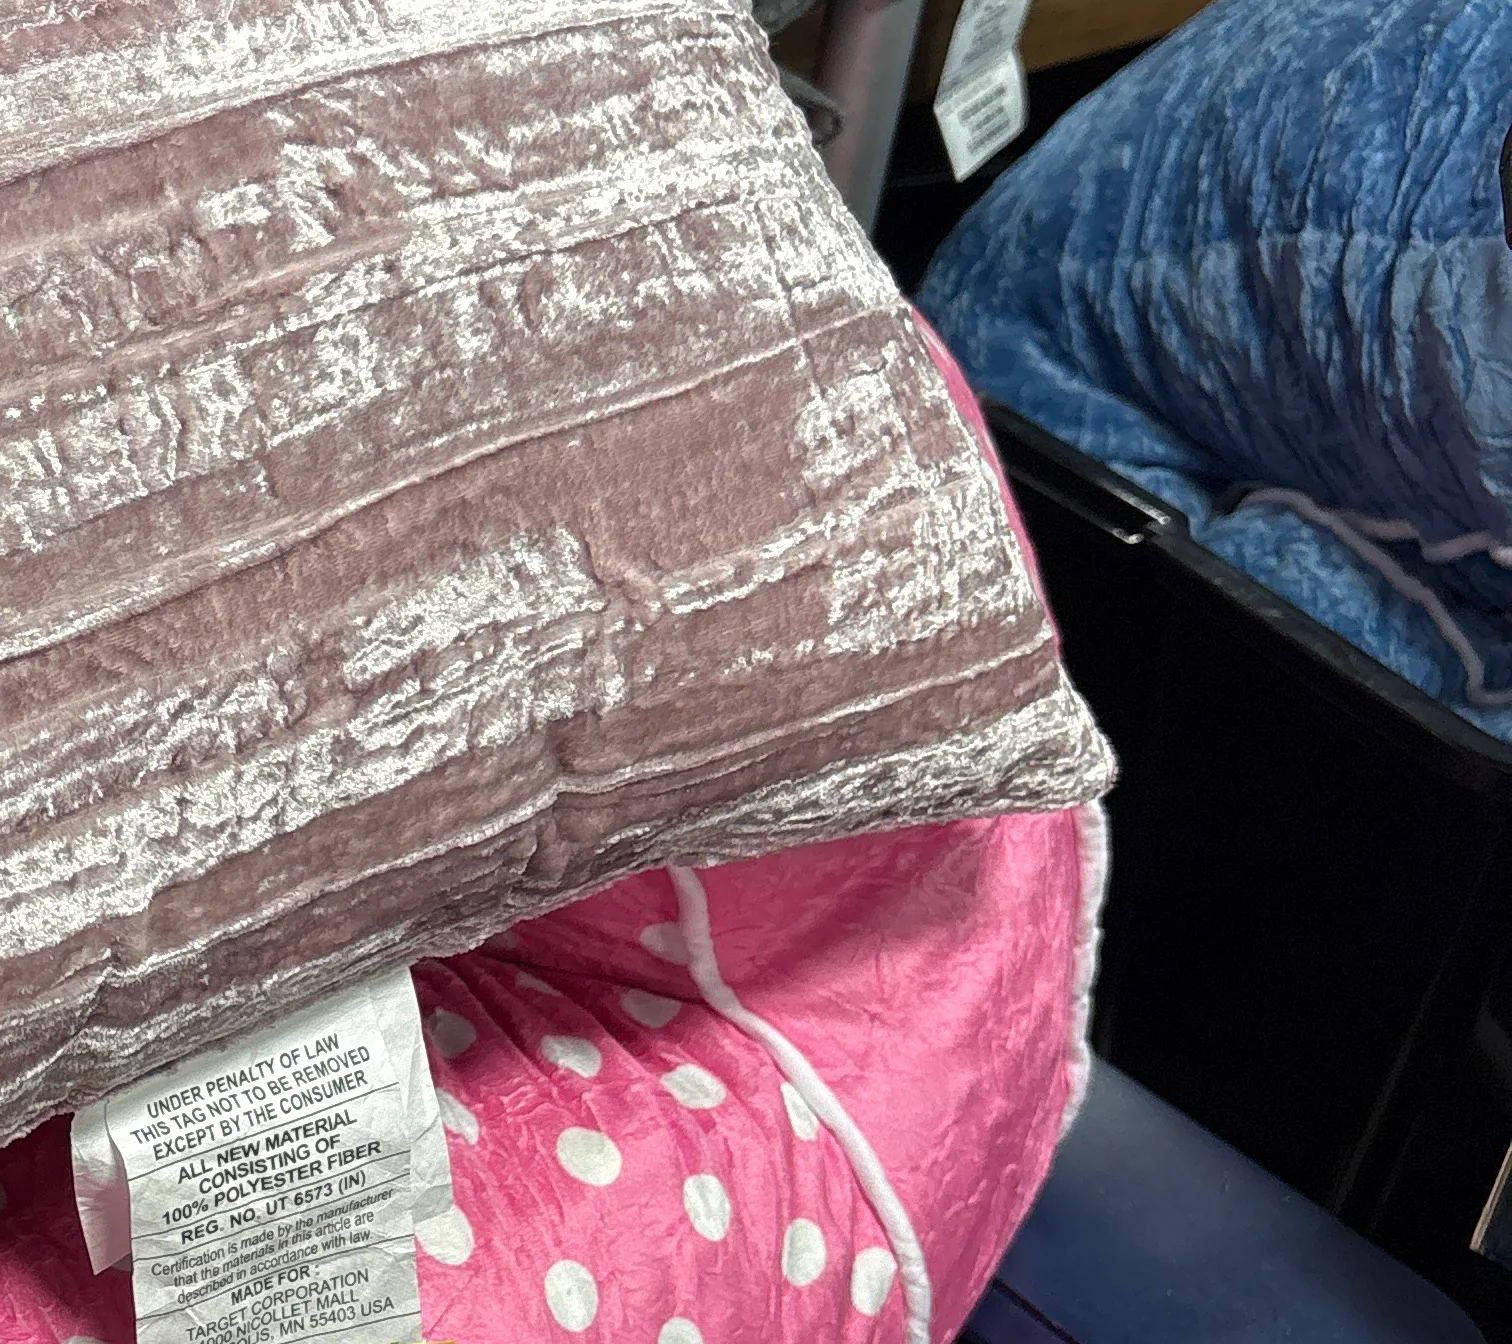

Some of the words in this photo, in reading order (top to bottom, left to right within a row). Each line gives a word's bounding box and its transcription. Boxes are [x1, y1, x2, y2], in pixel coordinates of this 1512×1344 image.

[130, 1121, 170, 1145] THIS
[170, 1106, 206, 1131] TAG
[209, 1094, 240, 1118] NOT
[241, 1086, 266, 1107] TO
[267, 1076, 291, 1097] BE
[295, 1046, 369, 1087] REMOVED
[147, 1086, 204, 1118] UNDER
[206, 1058, 275, 1097] PENALTY
[280, 1048, 300, 1069] OF
[304, 1033, 339, 1061] LAW
[153, 1125, 215, 1161] EXCEPT
[222, 1114, 240, 1137] BY
[244, 1103, 277, 1127] THE
[281, 1069, 368, 1115] CONSUMER
[178, 1159, 213, 1184] ALL
[218, 1141, 260, 1166] NEW
[266, 1109, 357, 1151] MATERIAL
[162, 1198, 208, 1225] 100%
[215, 1158, 323, 1207] POLYESTER
[327, 1140, 381, 1170] FIBER
[199, 1147, 310, 1194] CONSISTING
[315, 1134, 340, 1154] OF
[151, 1246, 225, 1276] Certification
[228, 1242, 237, 1254] is
[240, 1231, 274, 1250] made
[277, 1223, 291, 1242] by
[296, 1216, 313, 1230] the
[316, 1187, 394, 1224] manufacturer
[181, 1220, 225, 1245] REG.
[229, 1208, 260, 1229] NO.
[266, 1198, 289, 1216] UT
[294, 1182, 333, 1206] 6573
[339, 1170, 366, 1195] (IN)
[174, 1272, 198, 1288] that
[201, 1265, 220, 1281] the
[222, 1246, 274, 1273] materials
[278, 1238, 288, 1249] in
[291, 1230, 312, 1245] this
[315, 1219, 351, 1238] article
[354, 1212, 374, 1229] are
[177, 1273, 233, 1304] described
[238, 1266, 246, 1279] in
[249, 1243, 318, 1276] accordance
[321, 1235, 346, 1252] with
[349, 1229, 373, 1244] law.
[231, 1280, 273, 1305] MADE
[278, 1266, 310, 1284] FOR
[186, 1308, 248, 1341] TARGET
[252, 1268, 369, 1314] CORPORATION
[236, 1300, 312, 1335] NICOLLET
[316, 1289, 359, 1310] MALL
[280, 1318, 305, 1336] MN
[310, 1307, 356, 1328] 55403
[361, 1298, 394, 1318] USA
